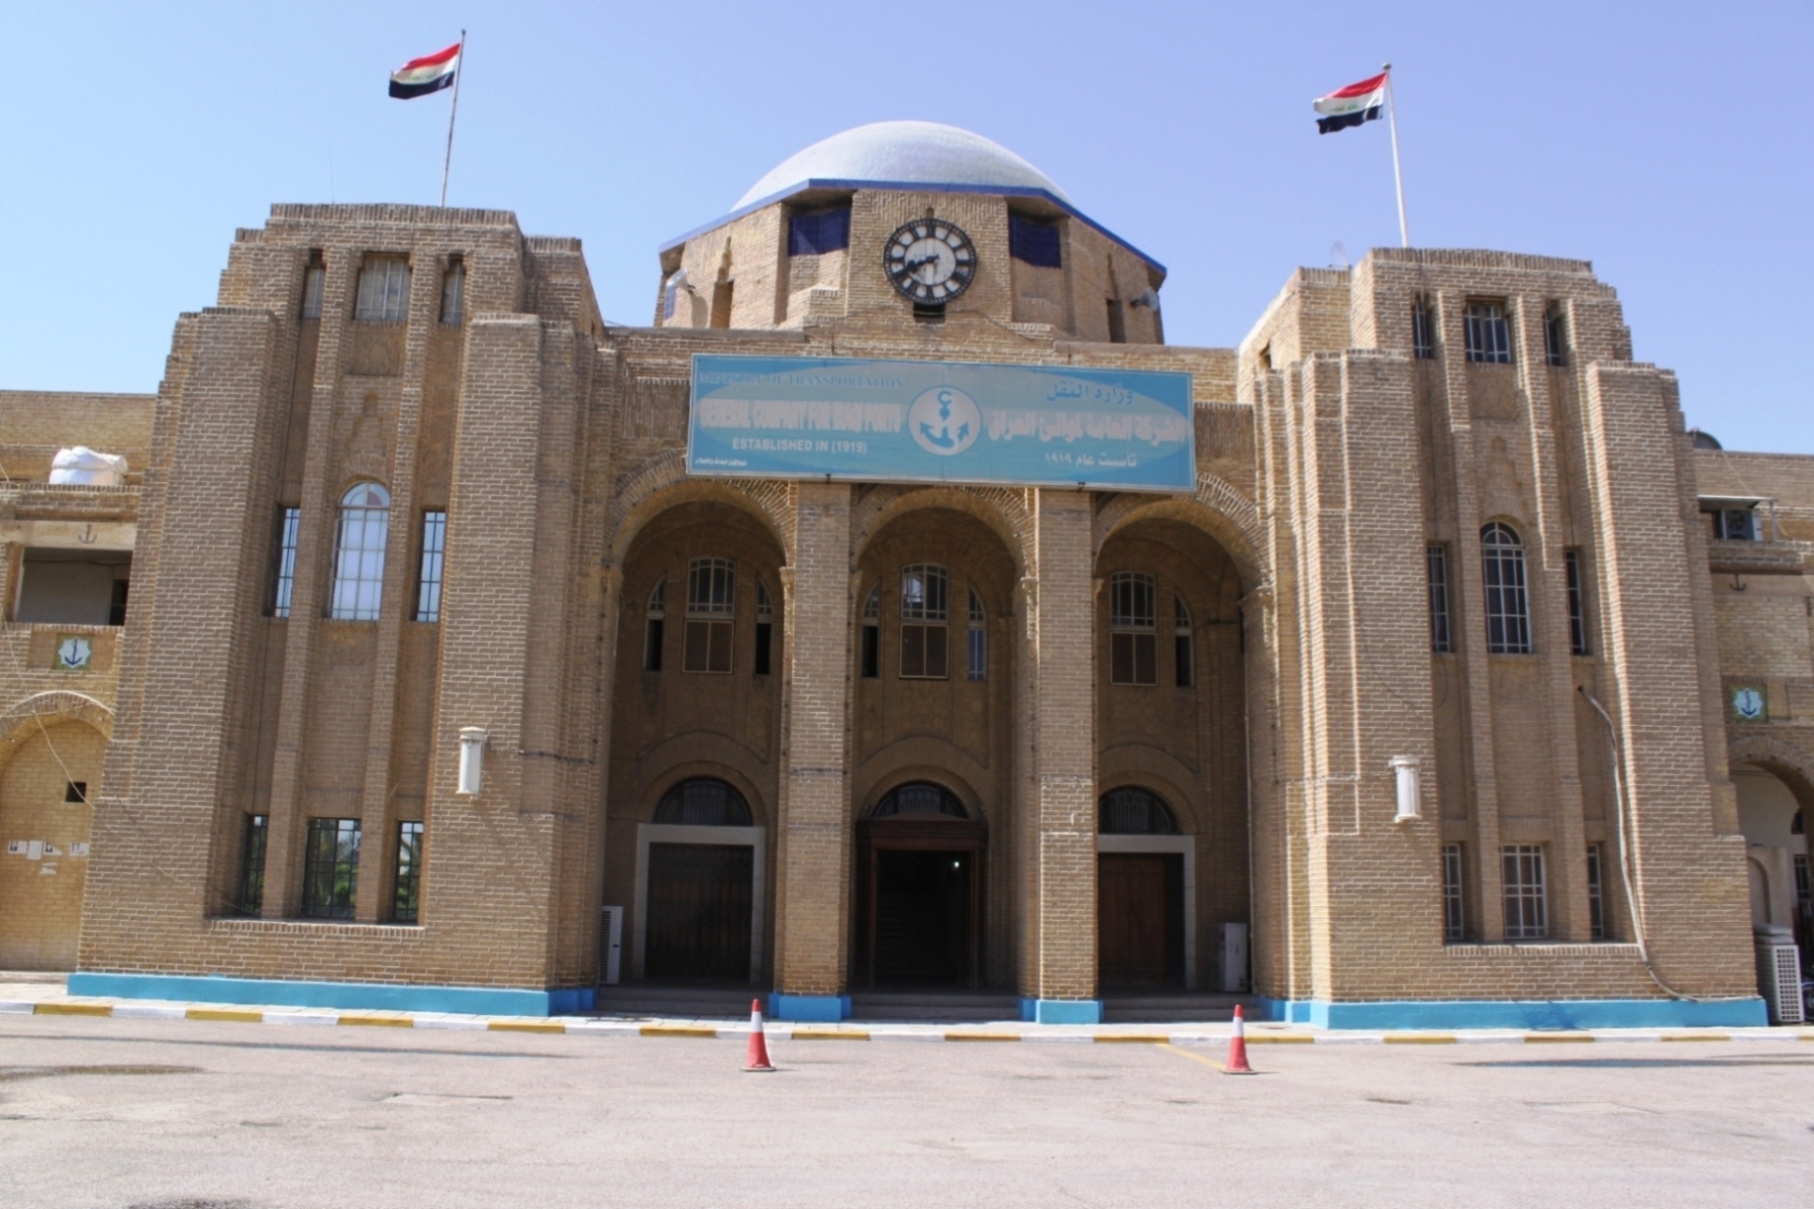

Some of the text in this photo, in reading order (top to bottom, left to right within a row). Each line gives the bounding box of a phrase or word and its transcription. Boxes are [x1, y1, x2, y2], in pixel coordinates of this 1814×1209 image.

[767, 374, 783, 385] OF
[789, 375, 904, 388] TRANSPORTATION
[1047, 380, 1134, 405] وزارة النقل
[988, 410, 1036, 441] العراق
[1086, 412, 1132, 441] العامة
[1134, 413, 1185, 446] الشركة
[732, 438, 867, 455] ESTABLISHED IN (1919)
[1045, 452, 1072, 464] ١٩١٩
[1076, 453, 1095, 467] عام
